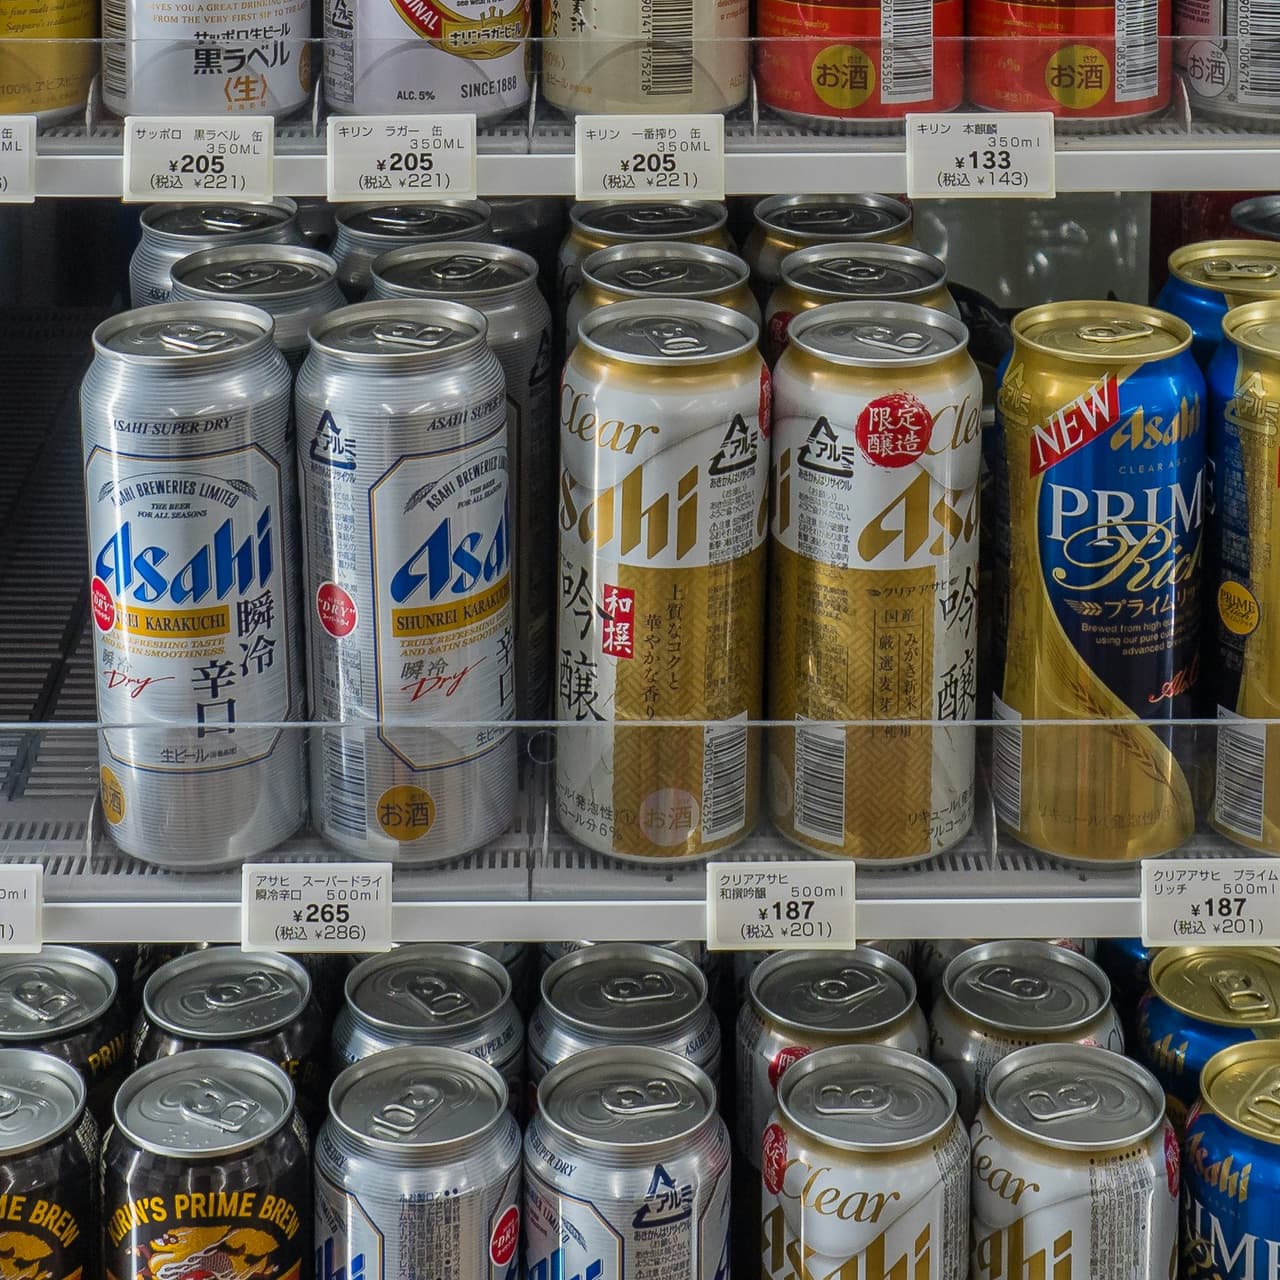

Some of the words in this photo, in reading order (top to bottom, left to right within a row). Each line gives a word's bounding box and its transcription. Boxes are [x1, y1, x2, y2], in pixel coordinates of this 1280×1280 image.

[194, 44, 289, 74] 黒ラベル
[397, 91, 416, 100] ALC.
[419, 90, 435, 100] 5%
[460, 81, 494, 98] SINCE
[496, 76, 517, 93] 1888
[410, 139, 464, 149] 350ML
[169, 155, 224, 174] ¥205
[377, 153, 433, 171] ¥205
[621, 154, 676, 172] ¥205
[956, 151, 1010, 169] ¥133
[202, 417, 232, 431] DRY
[869, 407, 925, 429] 限定
[1035, 373, 1118, 472] NEW
[1111, 403, 1199, 451] Asahi
[136, 480, 198, 503] BREWERIES
[199, 481, 240, 510] LIMITED
[97, 506, 274, 606] Asahi
[145, 614, 227, 632] KARAKUCHI
[396, 610, 457, 630] SHUNREI
[381, 800, 430, 828] お酒
[327, 890, 378, 900] 500ml
[792, 886, 842, 897] 500ml
[293, 904, 349, 923] ¥265
[759, 901, 814, 920] ¥187
[1191, 898, 1246, 916] ¥187
[781, 1158, 899, 1222] Clear
[33, 1200, 81, 1247] BREW
[175, 1193, 253, 1217] PRIME
[260, 1196, 299, 1247] BREW
